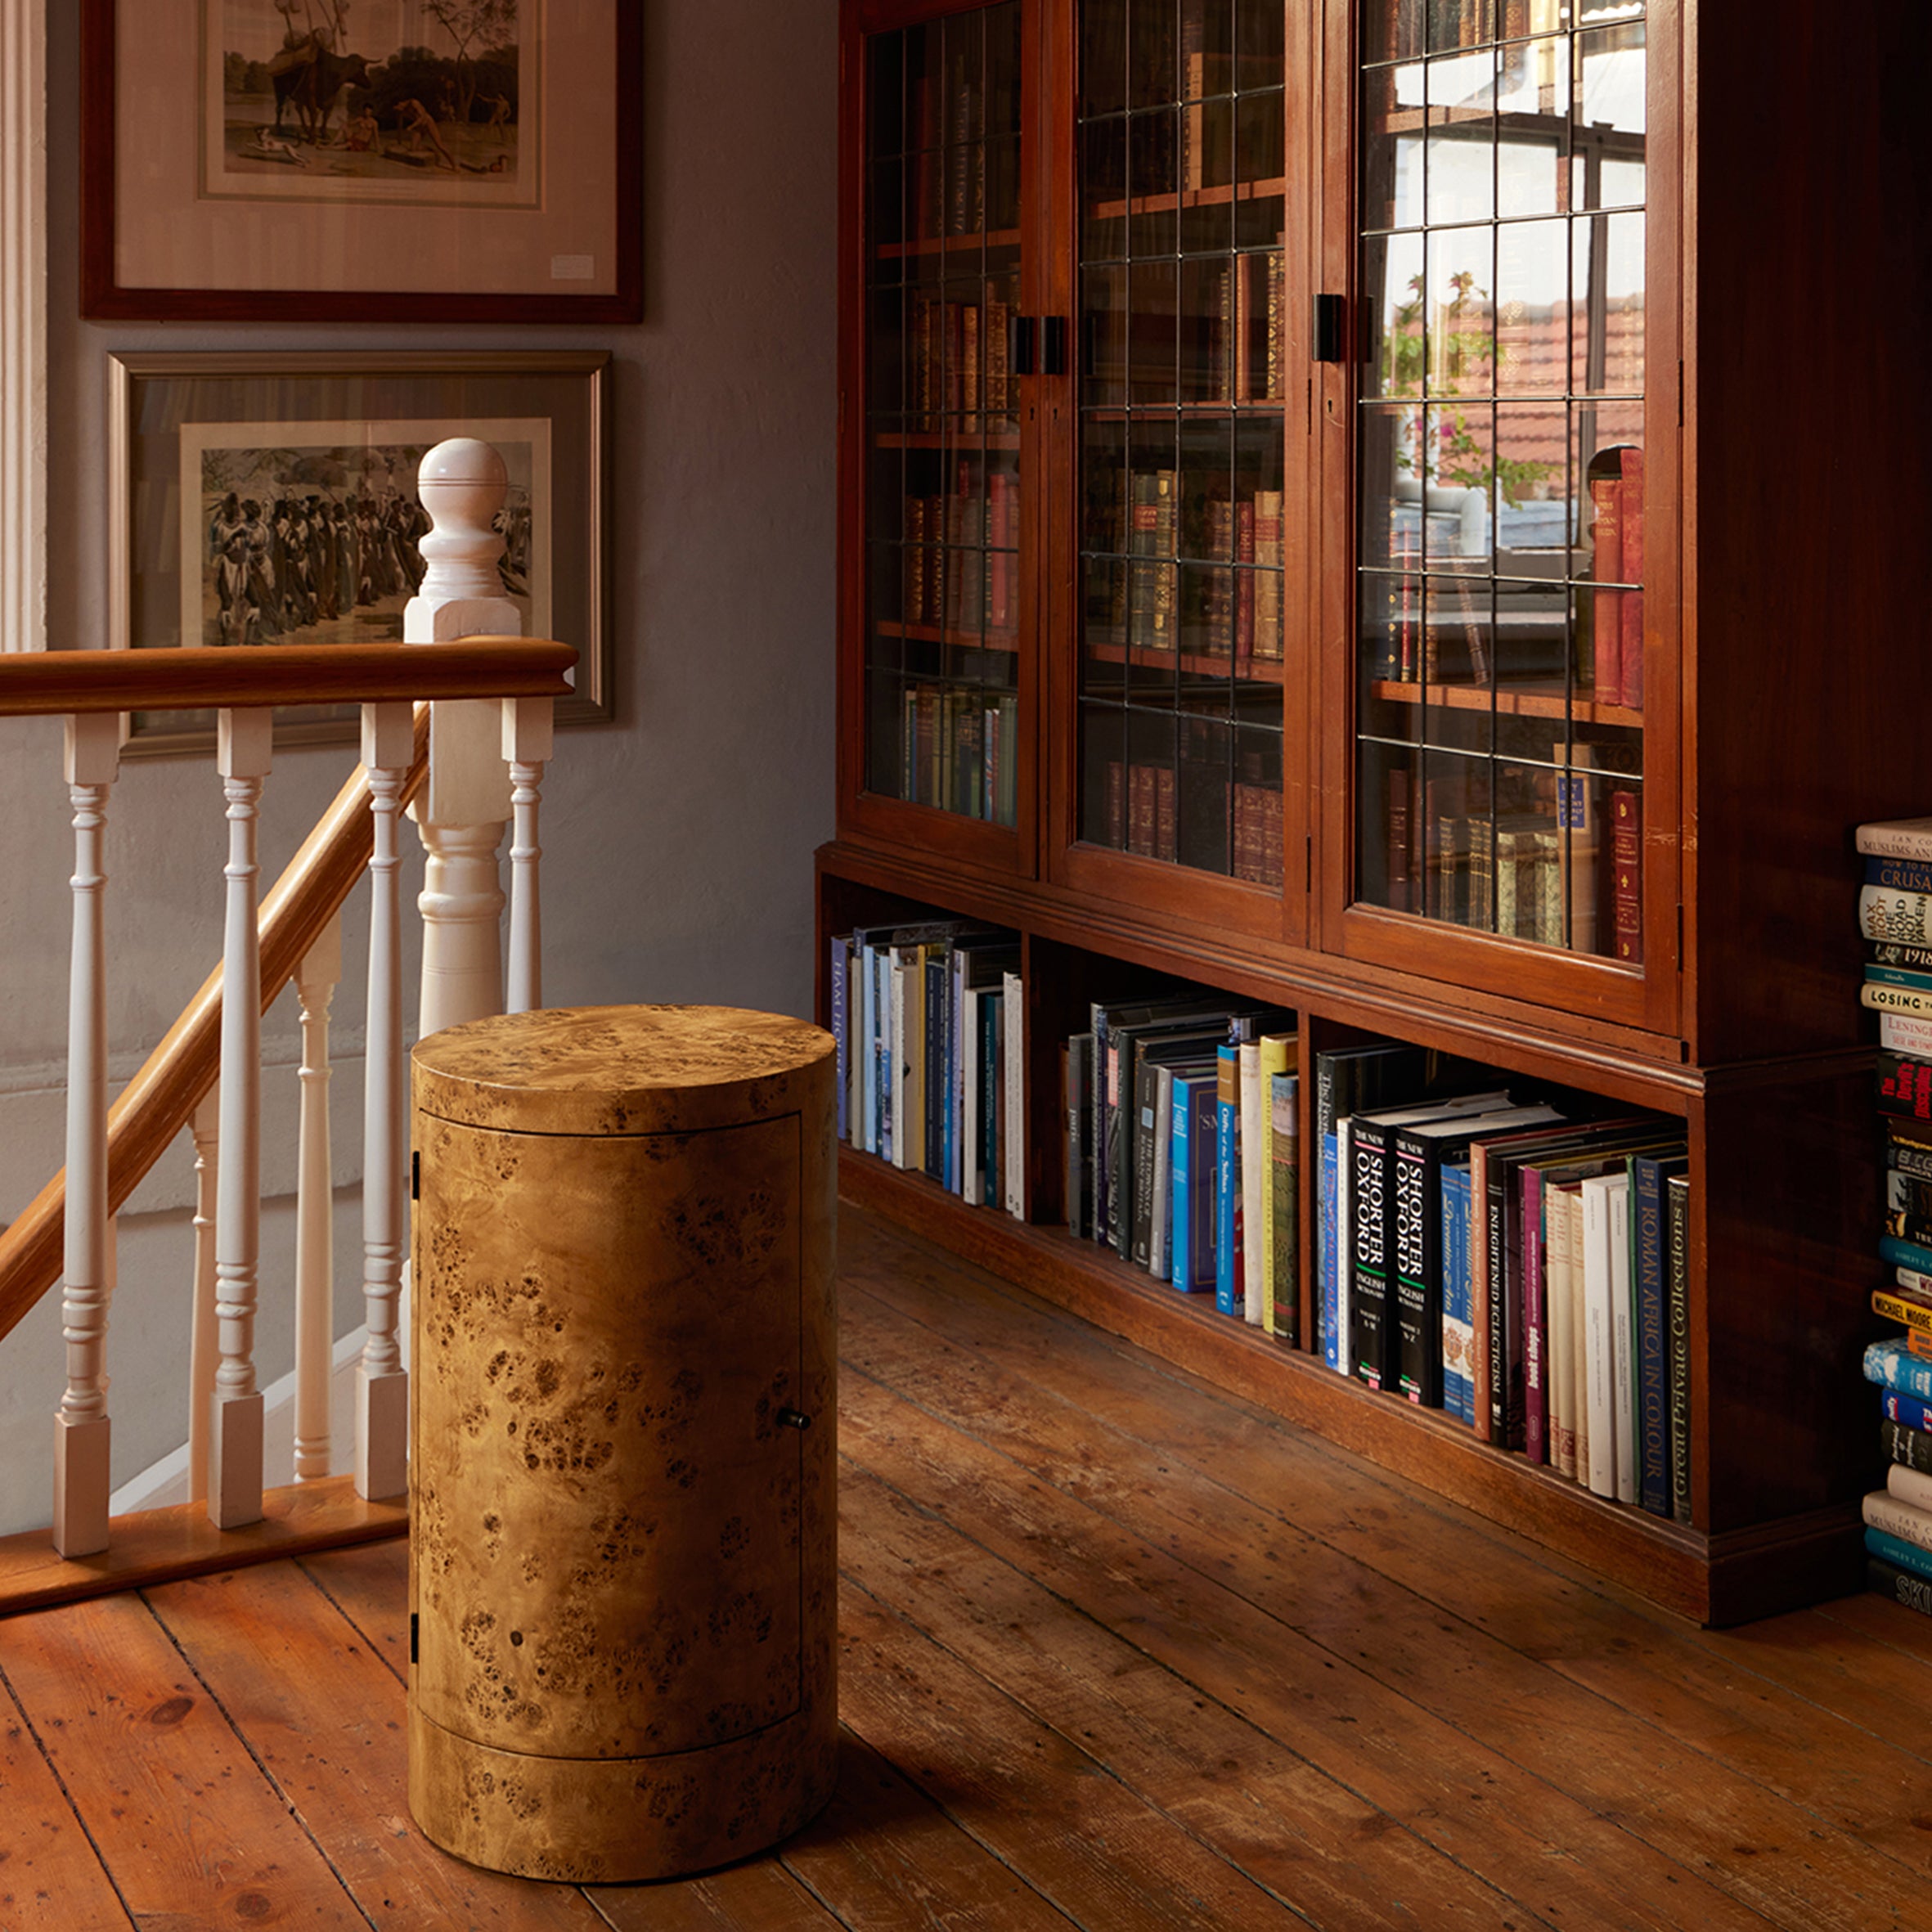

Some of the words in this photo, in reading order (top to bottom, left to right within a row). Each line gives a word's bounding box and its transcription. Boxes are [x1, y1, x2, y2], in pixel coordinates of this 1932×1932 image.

[1864, 841, 1911, 855] MUSLIMS
[1915, 847, 1932, 858] AN
[1893, 835, 1911, 843] IAN
[1867, 903, 1878, 937] MAX
[1876, 896, 1886, 938] BOOT
[1885, 911, 1896, 939] THE
[1896, 899, 1907, 941] ROAD
[1906, 914, 1916, 943] NOT
[1915, 896, 1927, 943] TAKEN
[834, 961, 842, 1005] HAM
[1871, 991, 1921, 1009] LOSING
[1888, 1016, 1932, 1037] LENING
[1322, 1073, 1332, 1096] The
[1881, 1077, 1895, 1096] The
[1896, 1062, 1915, 1101] Devil's
[1914, 1066, 1932, 1119] Disciples
[1220, 1107, 1229, 1134] Gifts
[1139, 1134, 1147, 1172] ROMAN
[1144, 1136, 1153, 1157] THE
[1144, 1158, 1153, 1195] TOWNS
[1220, 1159, 1229, 1194] Sultan
[1137, 1175, 1146, 1223] BRITAIN
[1356, 1151, 1370, 1263] OXFORD
[1370, 1155, 1385, 1265] SHORTER
[1396, 1161, 1409, 1274] OXFORD
[1409, 1165, 1423, 1276] SHORTER
[1443, 1193, 1454, 1268] Decorative
[1489, 1205, 1500, 1303] ENLIGHTENED
[1642, 1206, 1658, 1287] ROMAN
[1444, 1270, 1454, 1312] Arts
[1670, 1206, 1687, 1337] Collections
[1642, 1289, 1660, 1360] AFRICA
[1876, 1296, 1904, 1320] MICHAEL
[1906, 1308, 1931, 1330] MOORE
[1490, 1305, 1502, 1394] ECLECTICISM
[1527, 1326, 1540, 1359] shops
[1527, 1360, 1539, 1389] book
[1644, 1364, 1661, 1386] IN
[1672, 1340, 1687, 1424] Private
[1645, 1391, 1663, 1480] COLOUR
[1674, 1431, 1687, 1496] Great
[1869, 1513, 1920, 1543] MUSLIMS
[1895, 1575, 1932, 1615] SKI
